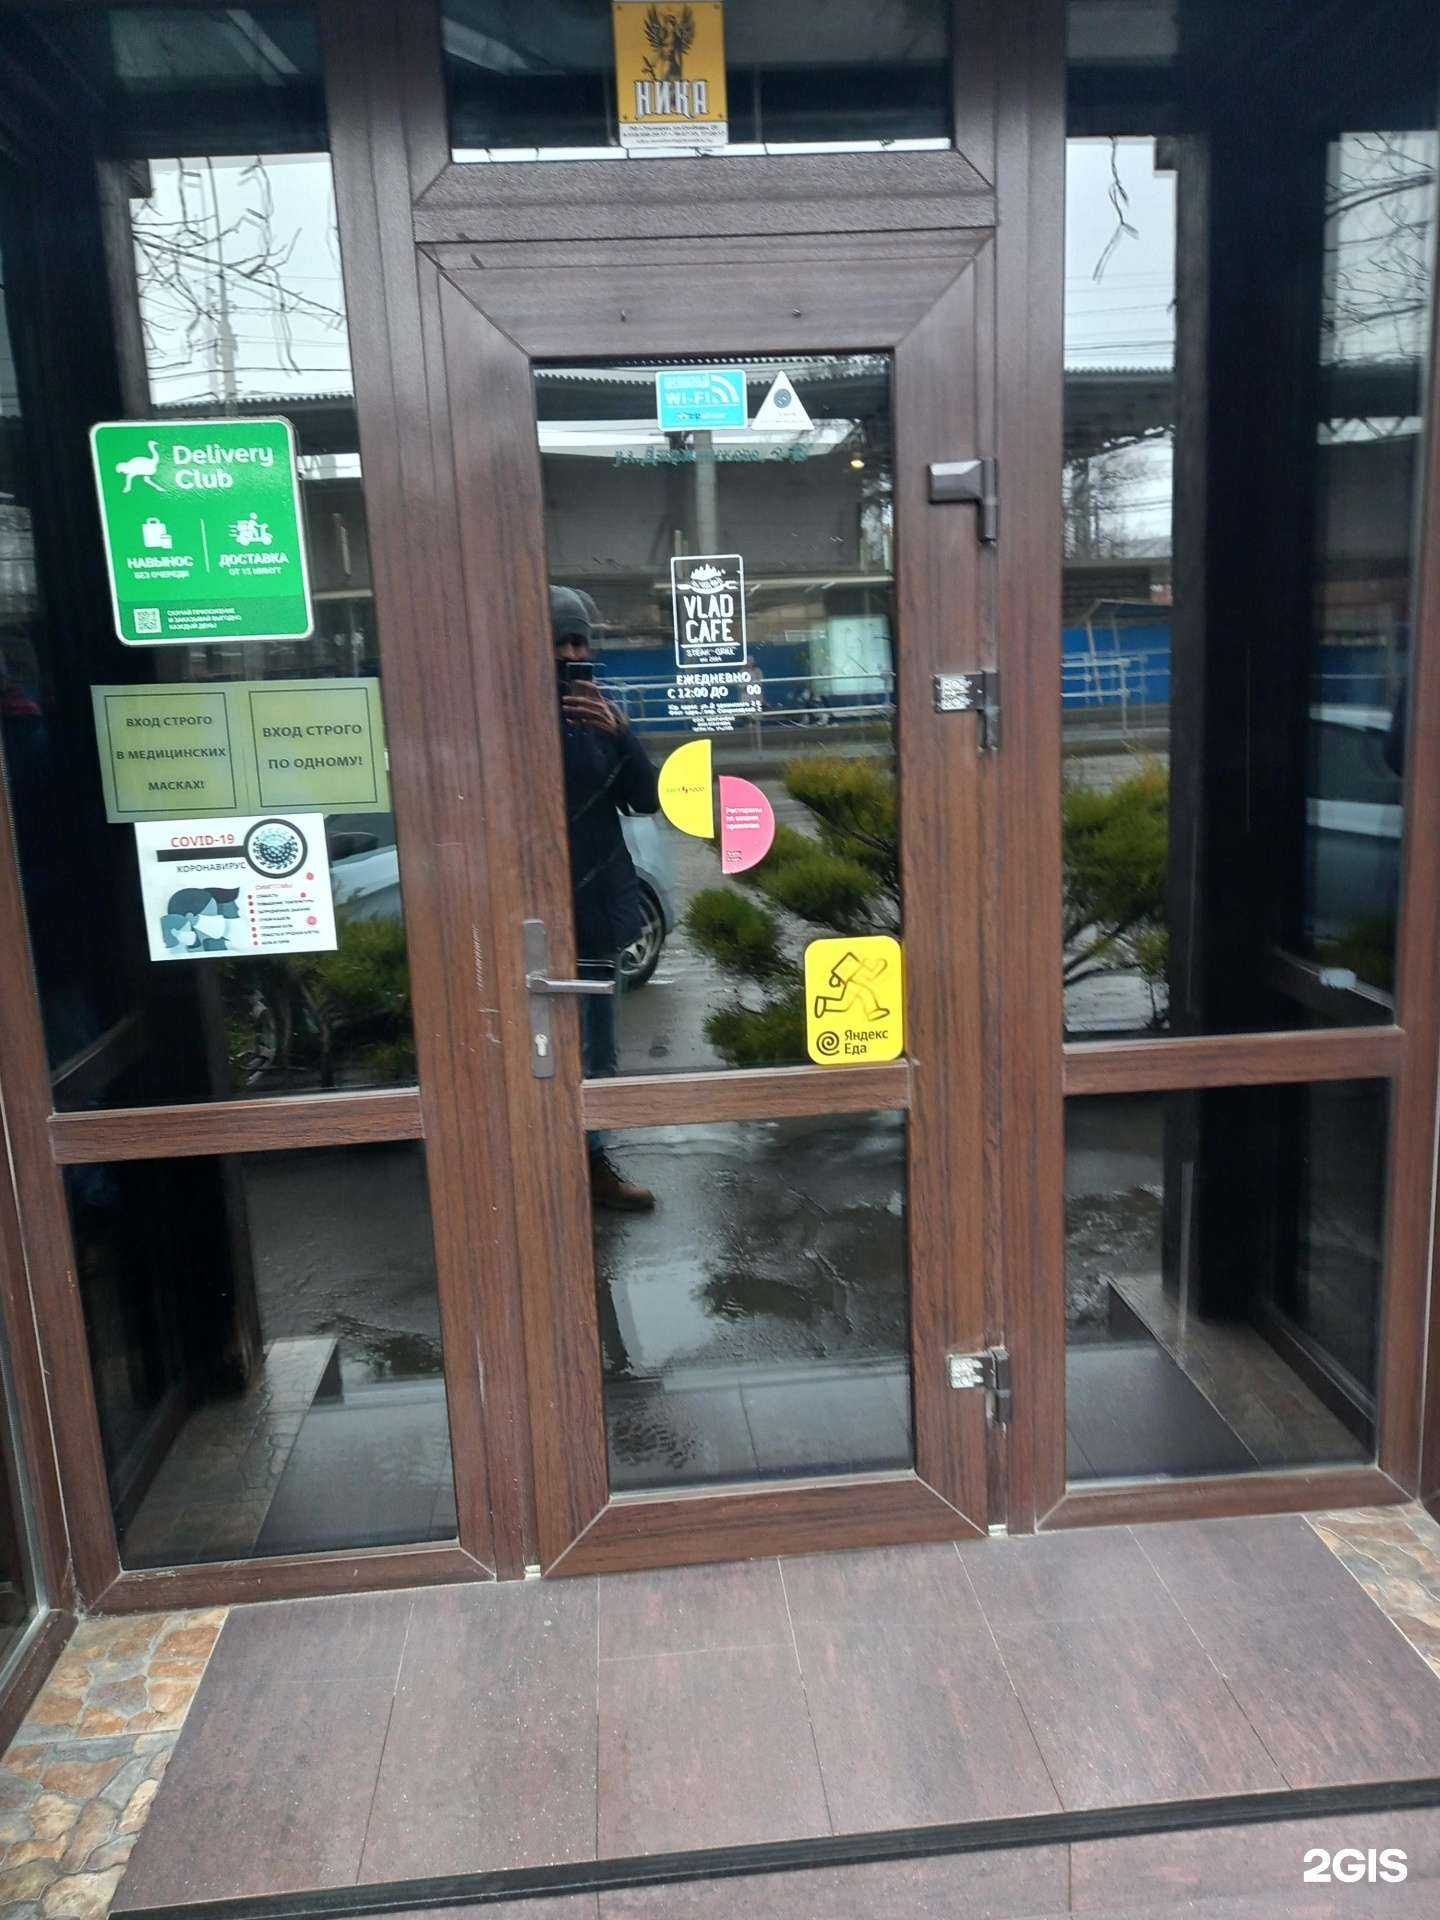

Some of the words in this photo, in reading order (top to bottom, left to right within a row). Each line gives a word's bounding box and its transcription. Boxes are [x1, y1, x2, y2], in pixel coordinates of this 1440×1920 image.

[634, 80, 710, 119] НИКА
[172, 444, 274, 467] Delivery
[175, 468, 234, 490] Club
[218, 552, 290, 568] ДОСТАВКА
[684, 593, 734, 619] VLAD
[685, 619, 734, 644] CAFE
[676, 671, 751, 686] ЕЖЕДНЕВНО
[709, 686, 728, 699] ДО
[126, 717, 160, 728] ВХОД
[163, 715, 212, 726] СТРОГО
[262, 727, 303, 739] ВХОД
[306, 724, 362, 736] СТРОГО
[116, 750, 124, 760] В
[128, 747, 226, 761] МЕДИЦИНСКИХ
[268, 758, 290, 769] ПО
[294, 756, 363, 770] ОДНОМУ!
[148, 780, 205, 791] МАСКАХ!
[170, 833, 235, 847] COVID-19
[176, 861, 247, 873] КОРОНАВИРУС
[844, 1029, 888, 1041] Яндекс
[844, 1043, 867, 1055] Еда
